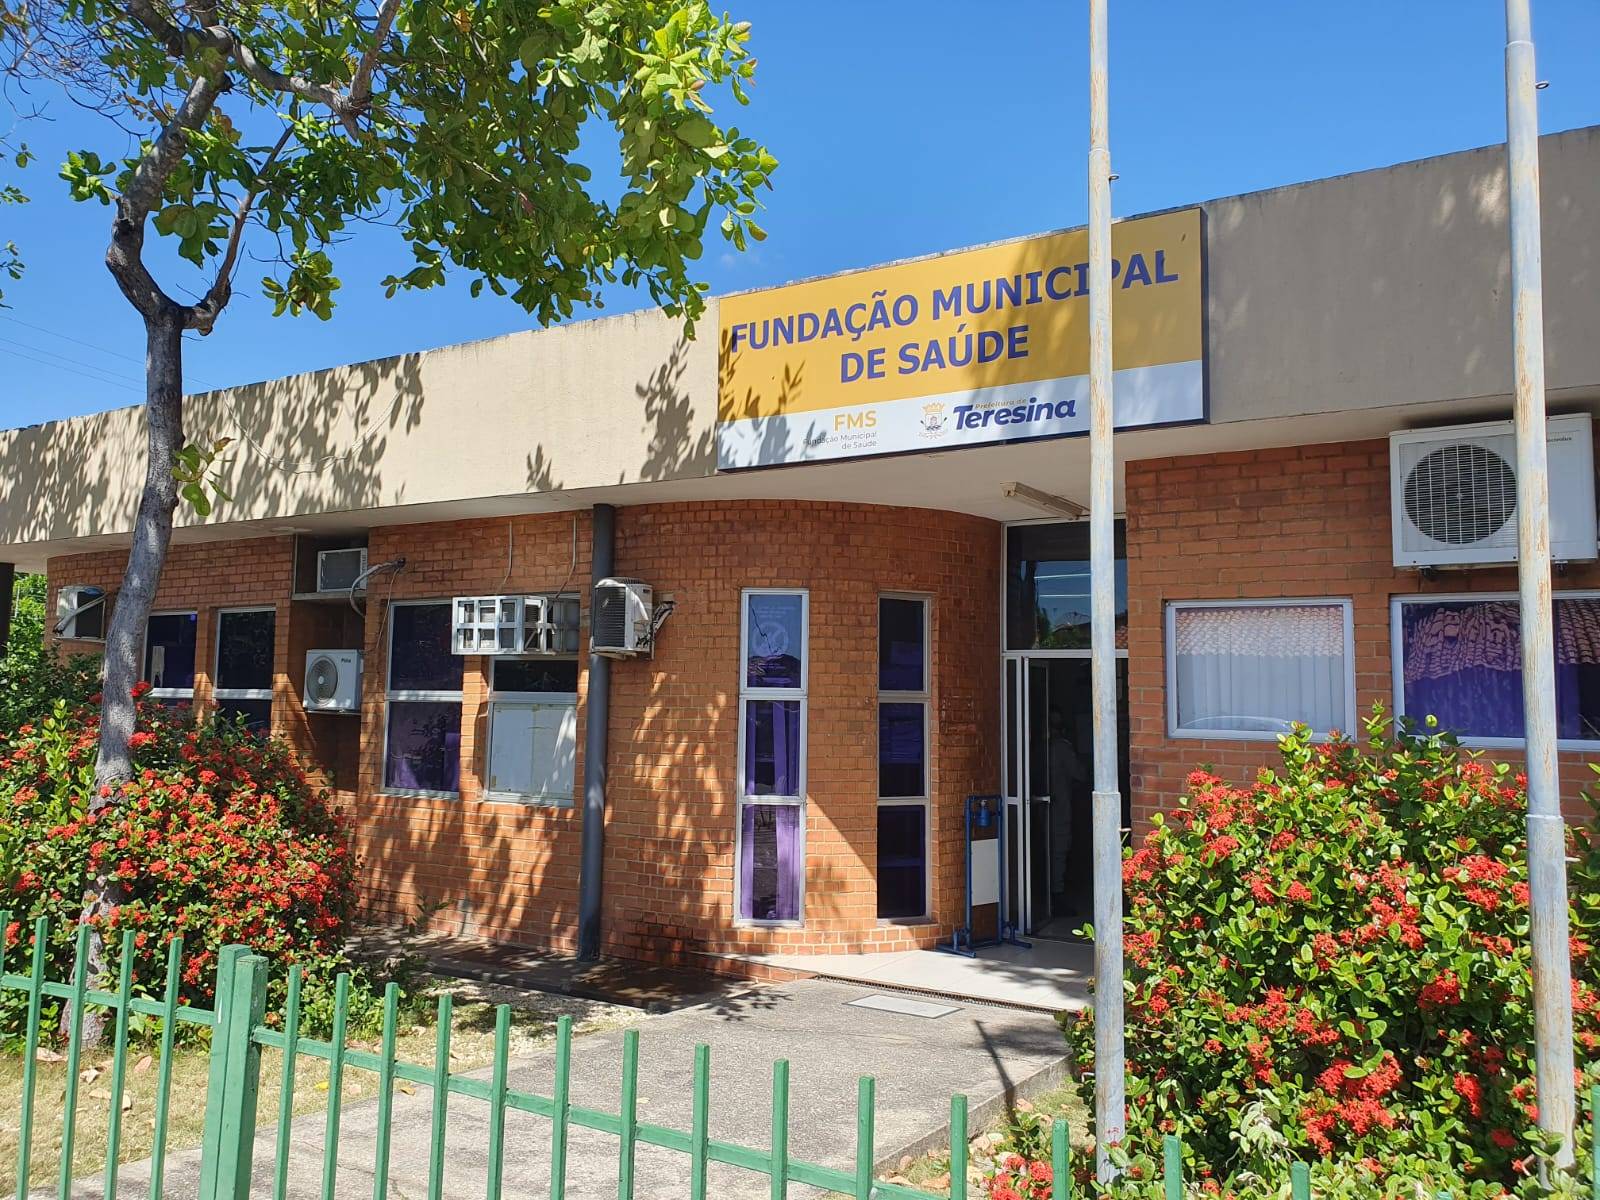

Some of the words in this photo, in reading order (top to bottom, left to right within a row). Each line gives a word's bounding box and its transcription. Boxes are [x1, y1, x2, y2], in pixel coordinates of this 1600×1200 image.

[731, 289, 919, 353] FUNDAÇÃO
[841, 347, 886, 384] DE
[898, 323, 1029, 375] SAÚDE
[953, 397, 1076, 430] Teresina
[975, 399, 1014, 410] Prefeitura
[834, 410, 877, 432] FMS
[841, 431, 877, 442] Municipal
[841, 441, 852, 450] de
